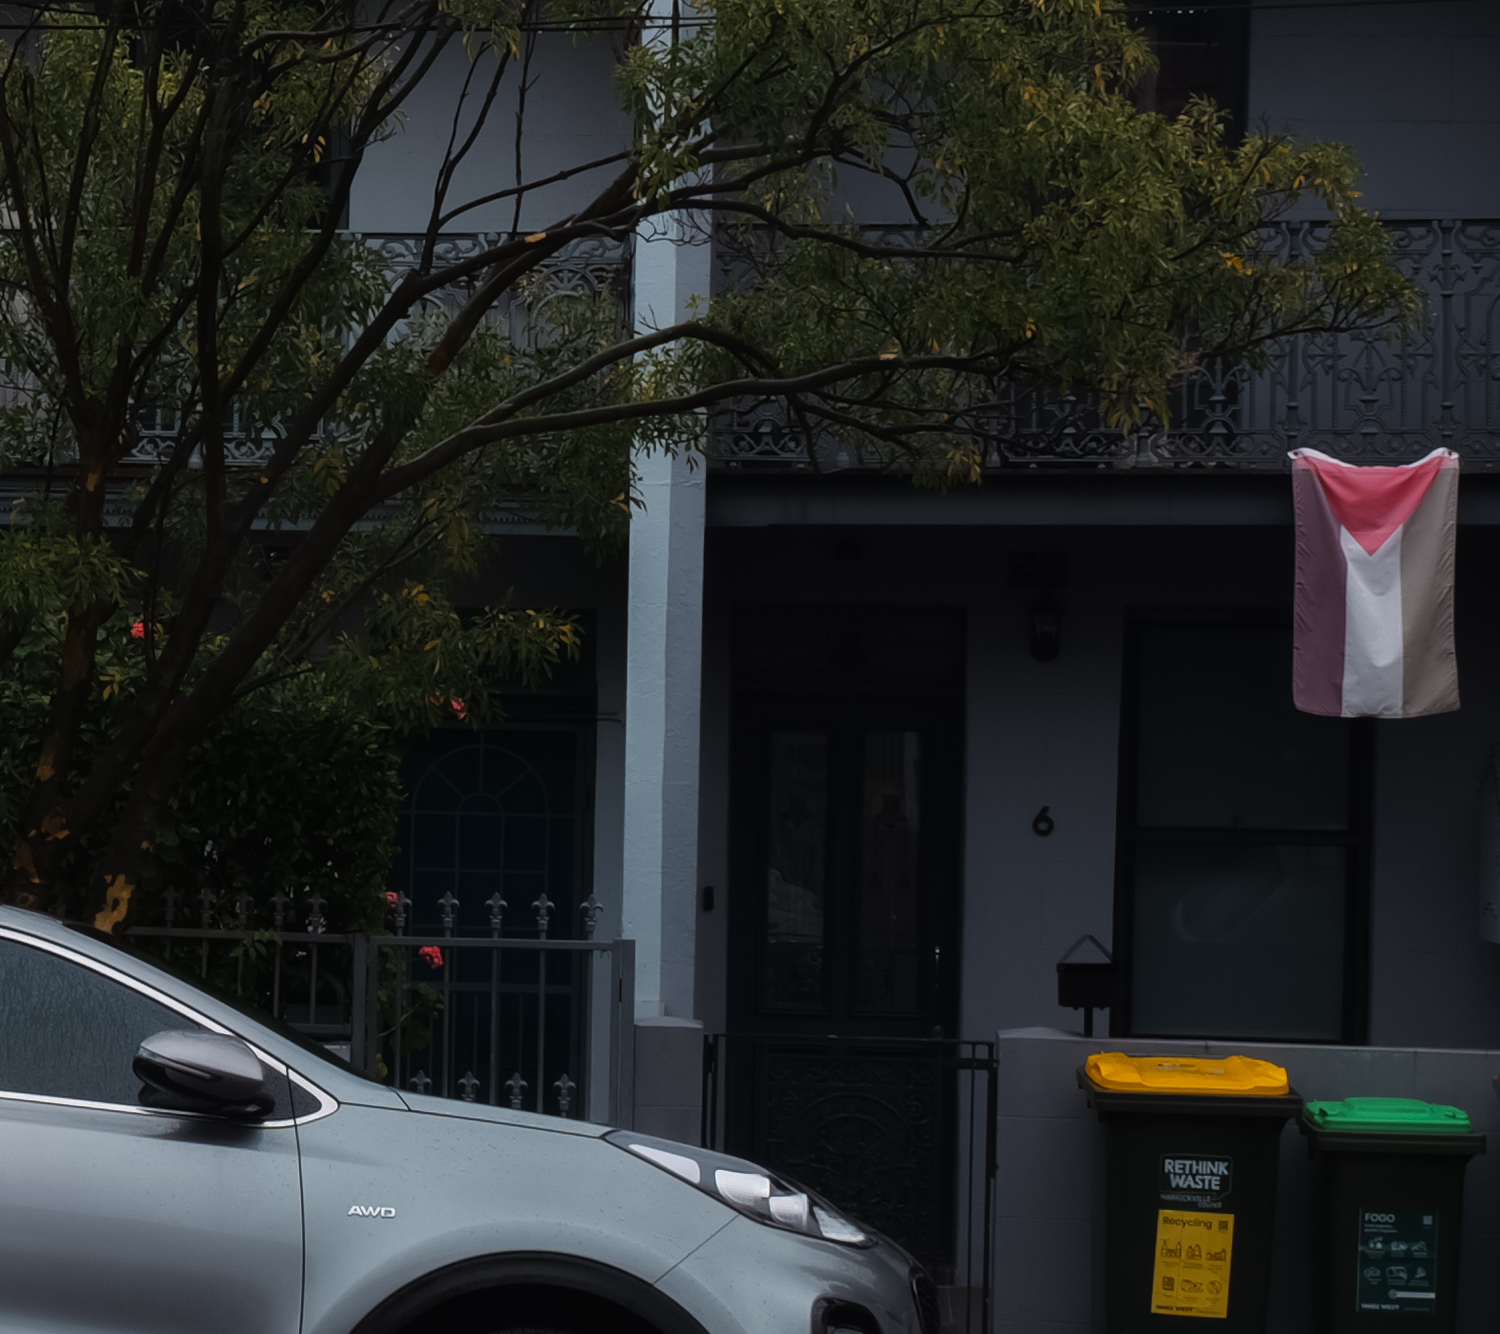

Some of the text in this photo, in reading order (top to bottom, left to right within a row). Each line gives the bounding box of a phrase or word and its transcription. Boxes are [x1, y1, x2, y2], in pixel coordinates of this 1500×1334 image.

[1032, 805, 1054, 837] 6
[1164, 1158, 1230, 1175] RETHINK
[1169, 1173, 1221, 1191] WASTE
[347, 1205, 396, 1218] AWD
[1364, 1212, 1396, 1223] FOGO
[1162, 1216, 1213, 1231] Recycling
